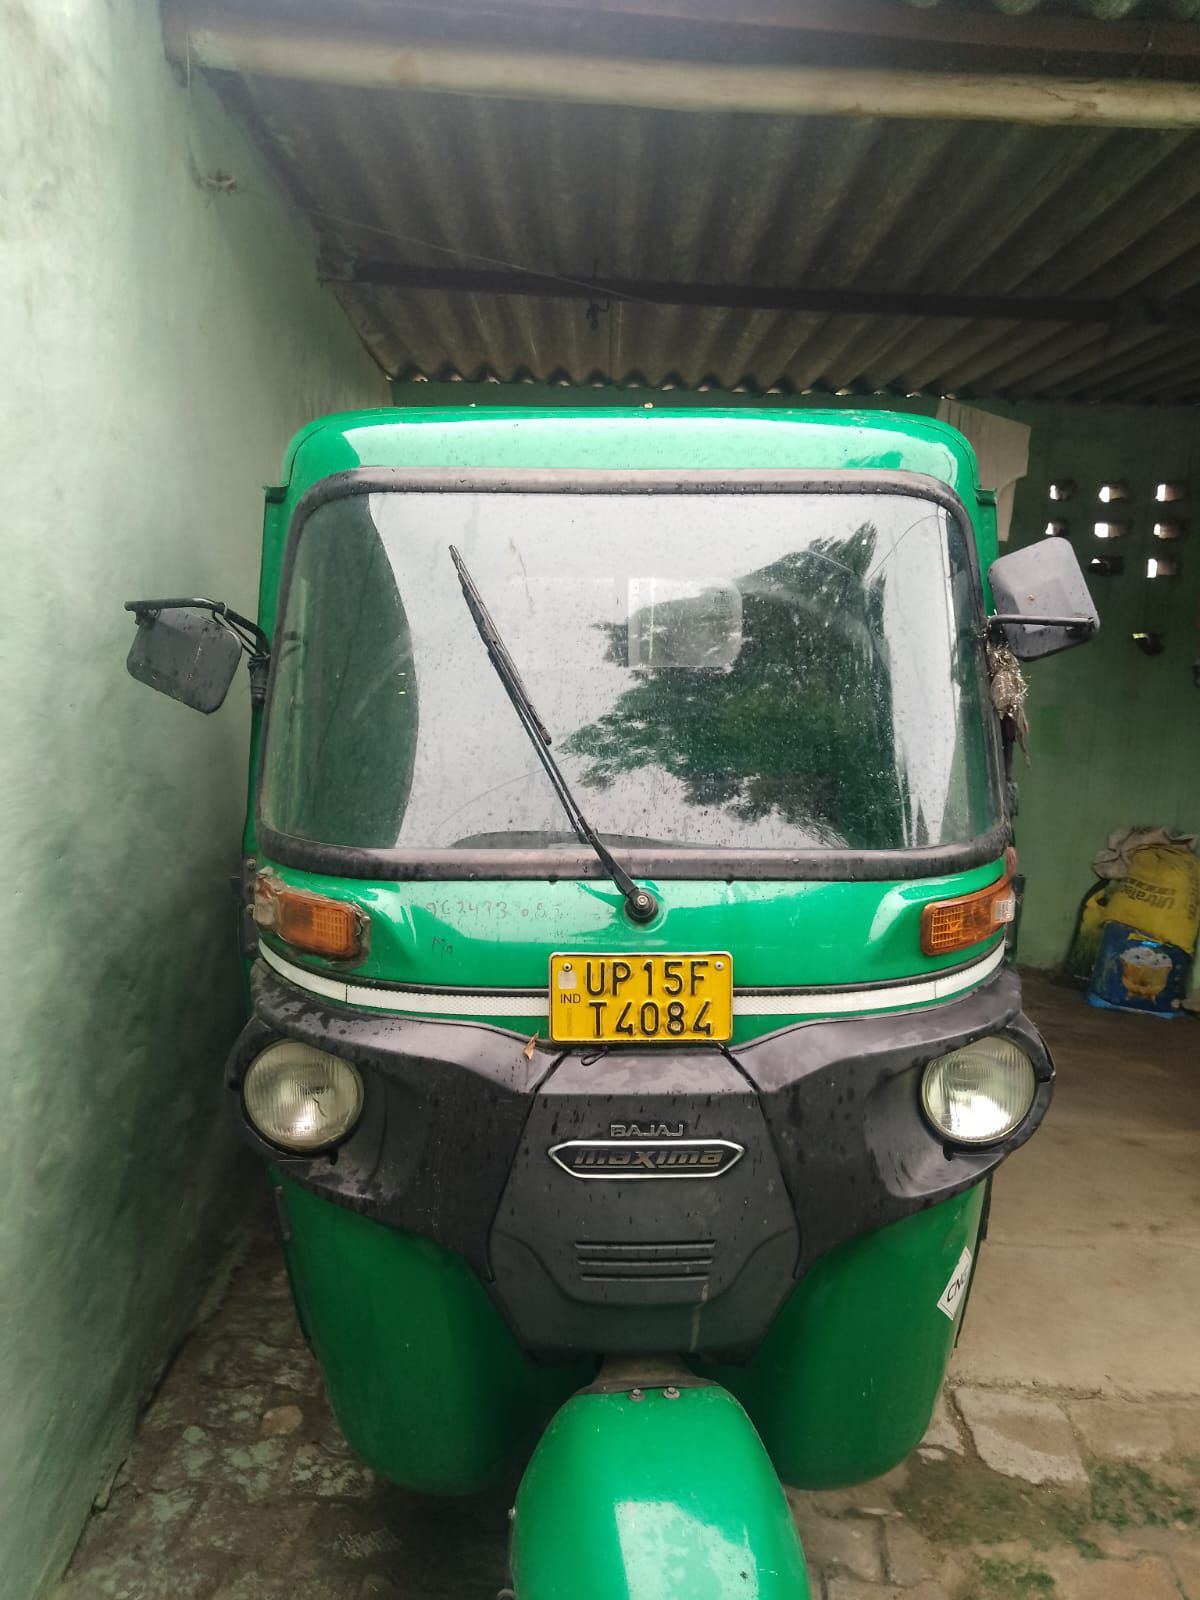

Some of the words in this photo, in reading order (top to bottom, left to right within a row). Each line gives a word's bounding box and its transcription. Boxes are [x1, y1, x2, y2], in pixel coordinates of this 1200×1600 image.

[560, 993, 581, 1004] IND
[588, 1000, 712, 1037] T4084
[610, 1123, 684, 1137] BAJAJ
